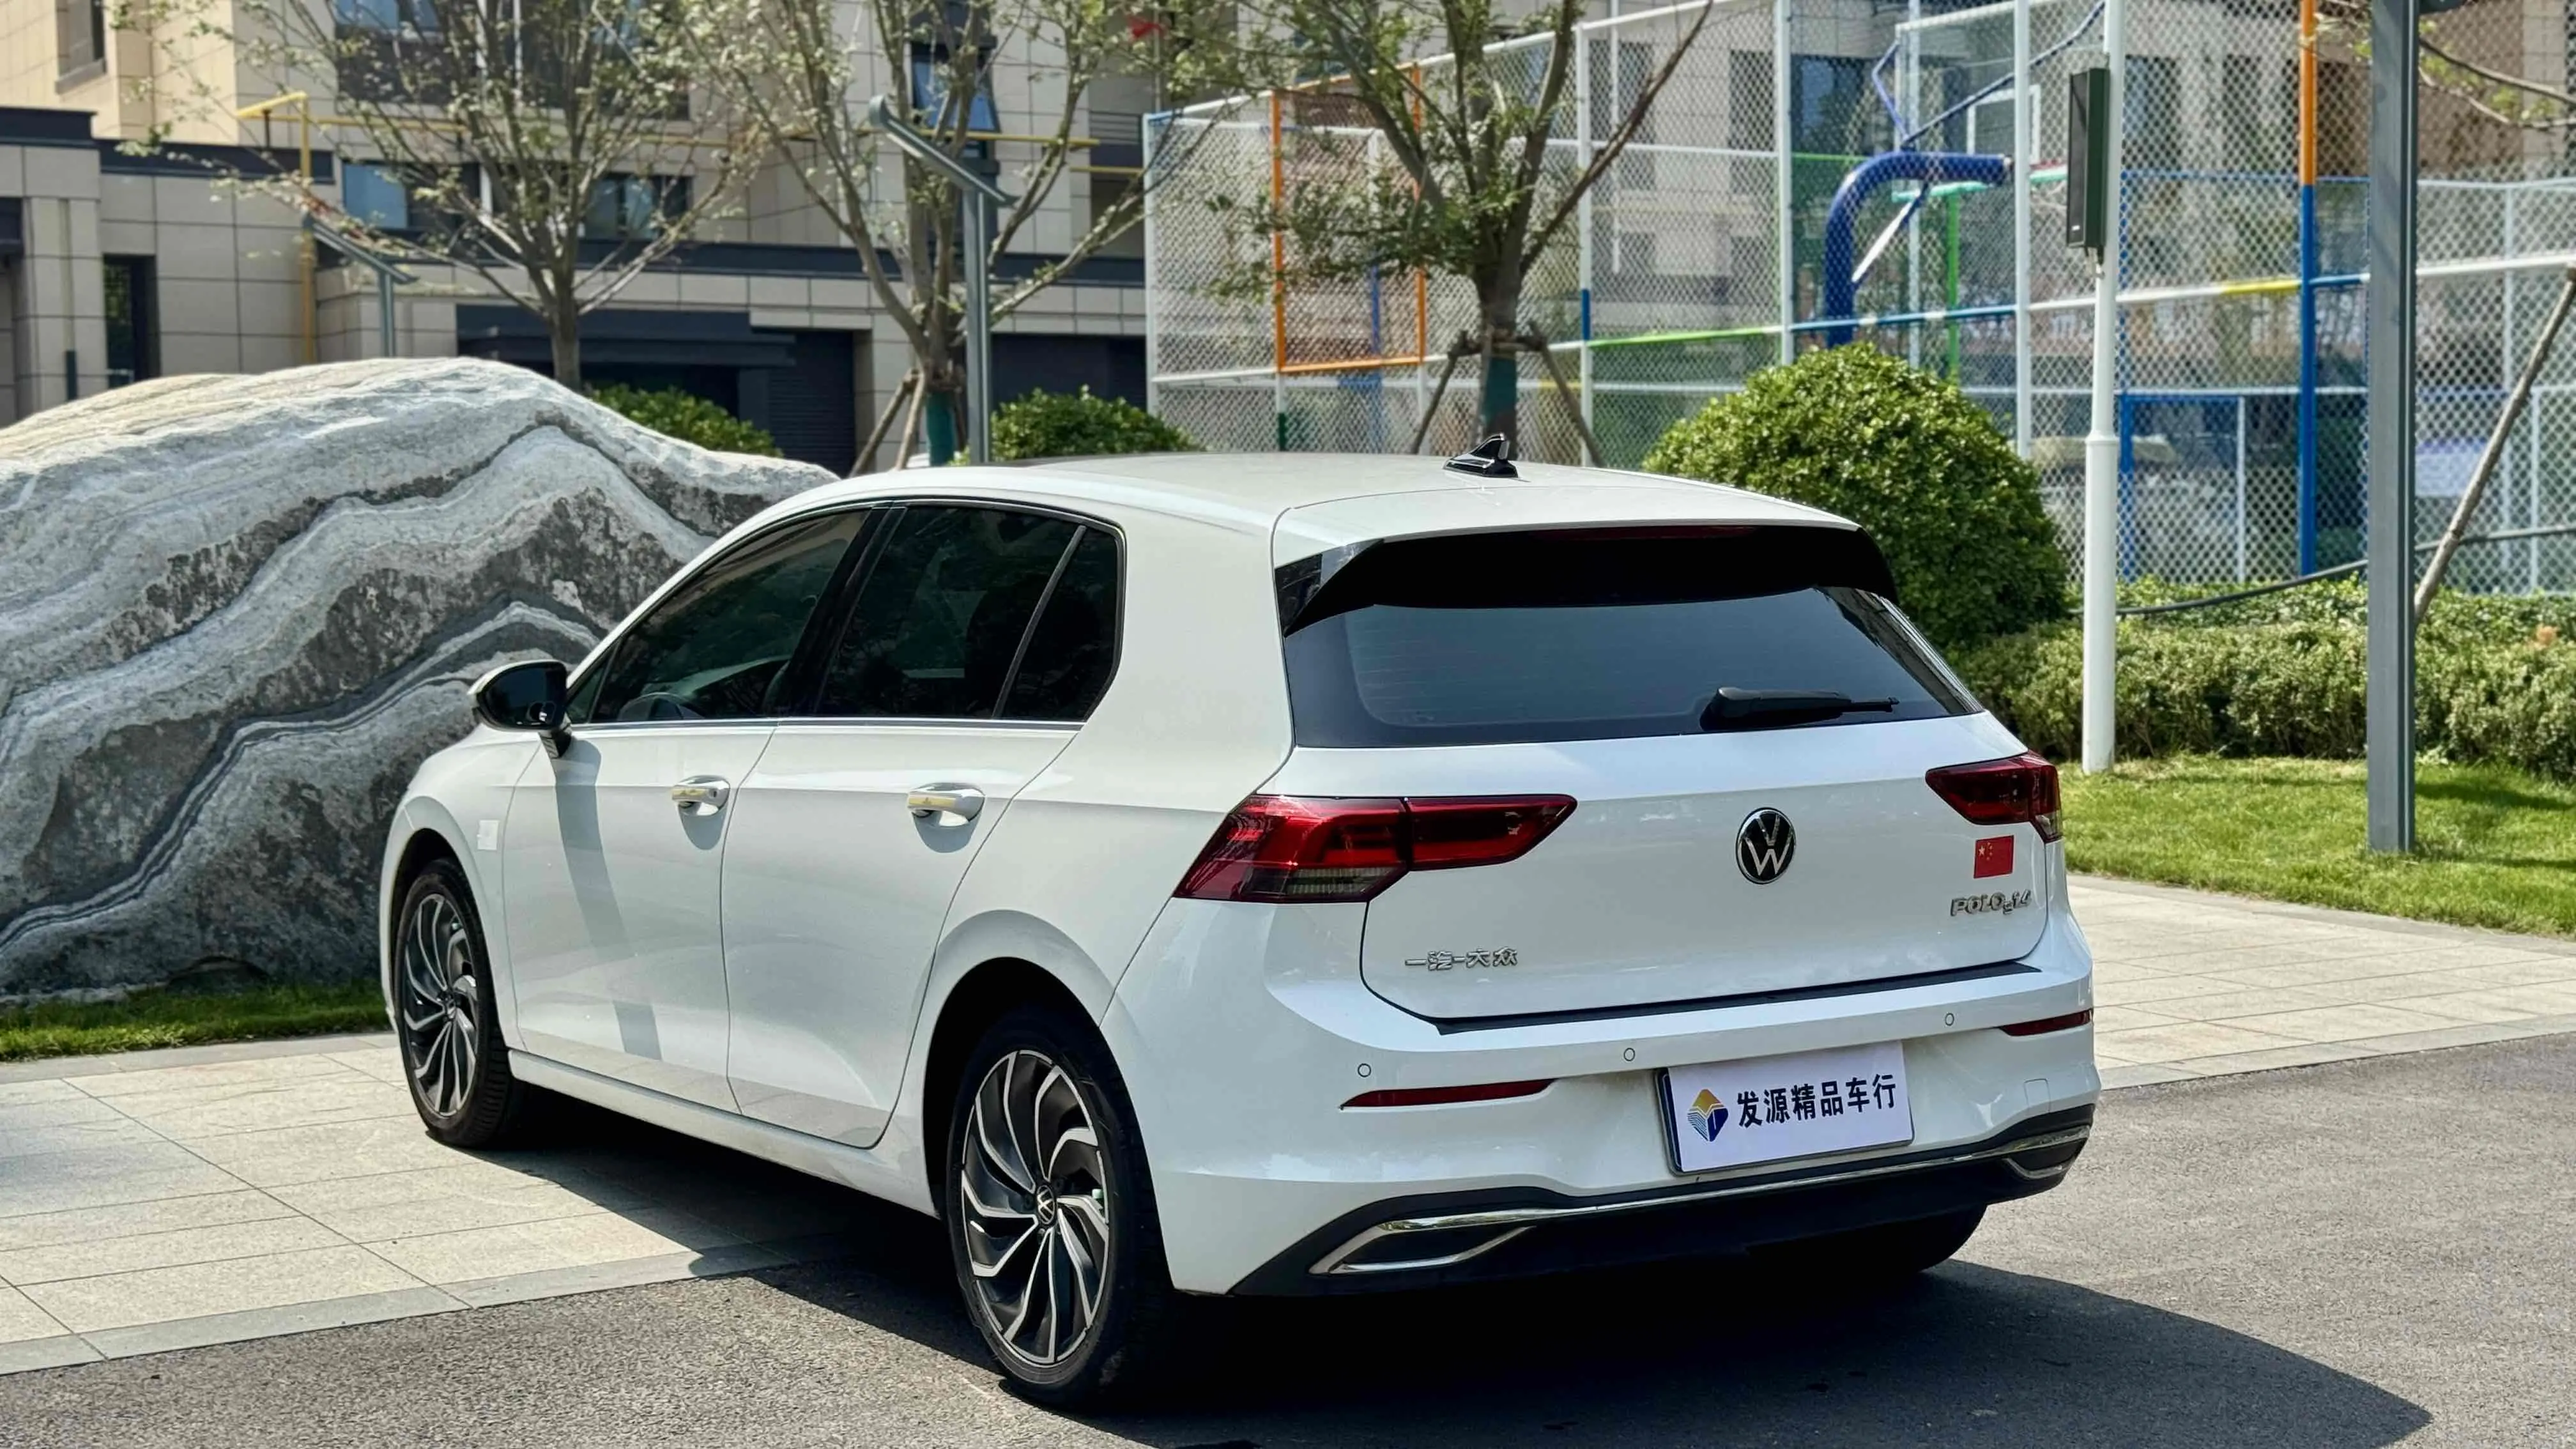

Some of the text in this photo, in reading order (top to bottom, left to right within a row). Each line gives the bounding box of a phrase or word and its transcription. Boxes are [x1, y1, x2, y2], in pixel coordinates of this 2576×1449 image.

[1737, 1073, 1896, 1128] 发源精品车行
